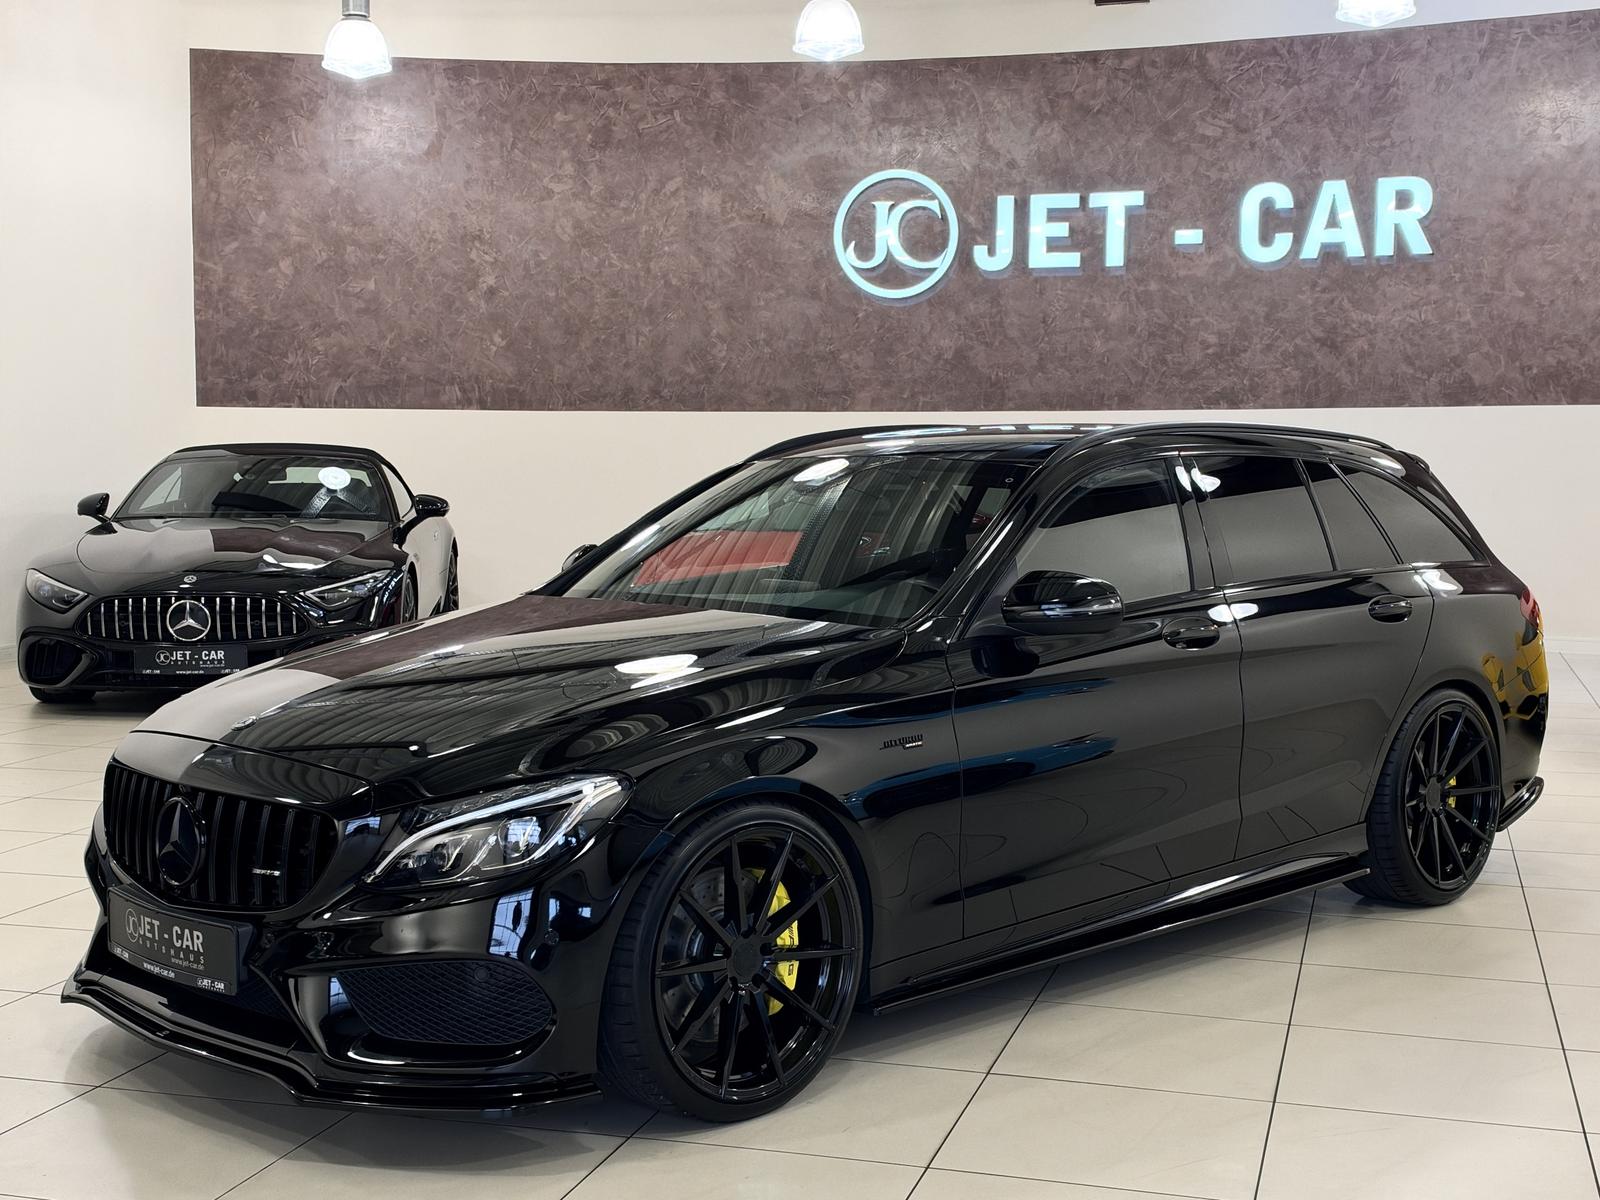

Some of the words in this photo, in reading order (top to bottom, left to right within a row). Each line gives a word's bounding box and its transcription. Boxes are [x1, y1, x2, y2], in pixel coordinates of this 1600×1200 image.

[972, 190, 1145, 272] JET
[1174, 228, 1204, 246] -
[1239, 175, 1435, 263] CAR
[170, 650, 192, 661] JET
[202, 650, 225, 660] CAR
[139, 914, 160, 940] JET
[172, 925, 204, 953] CAR
[139, 937, 205, 964] AUTOHAUS
